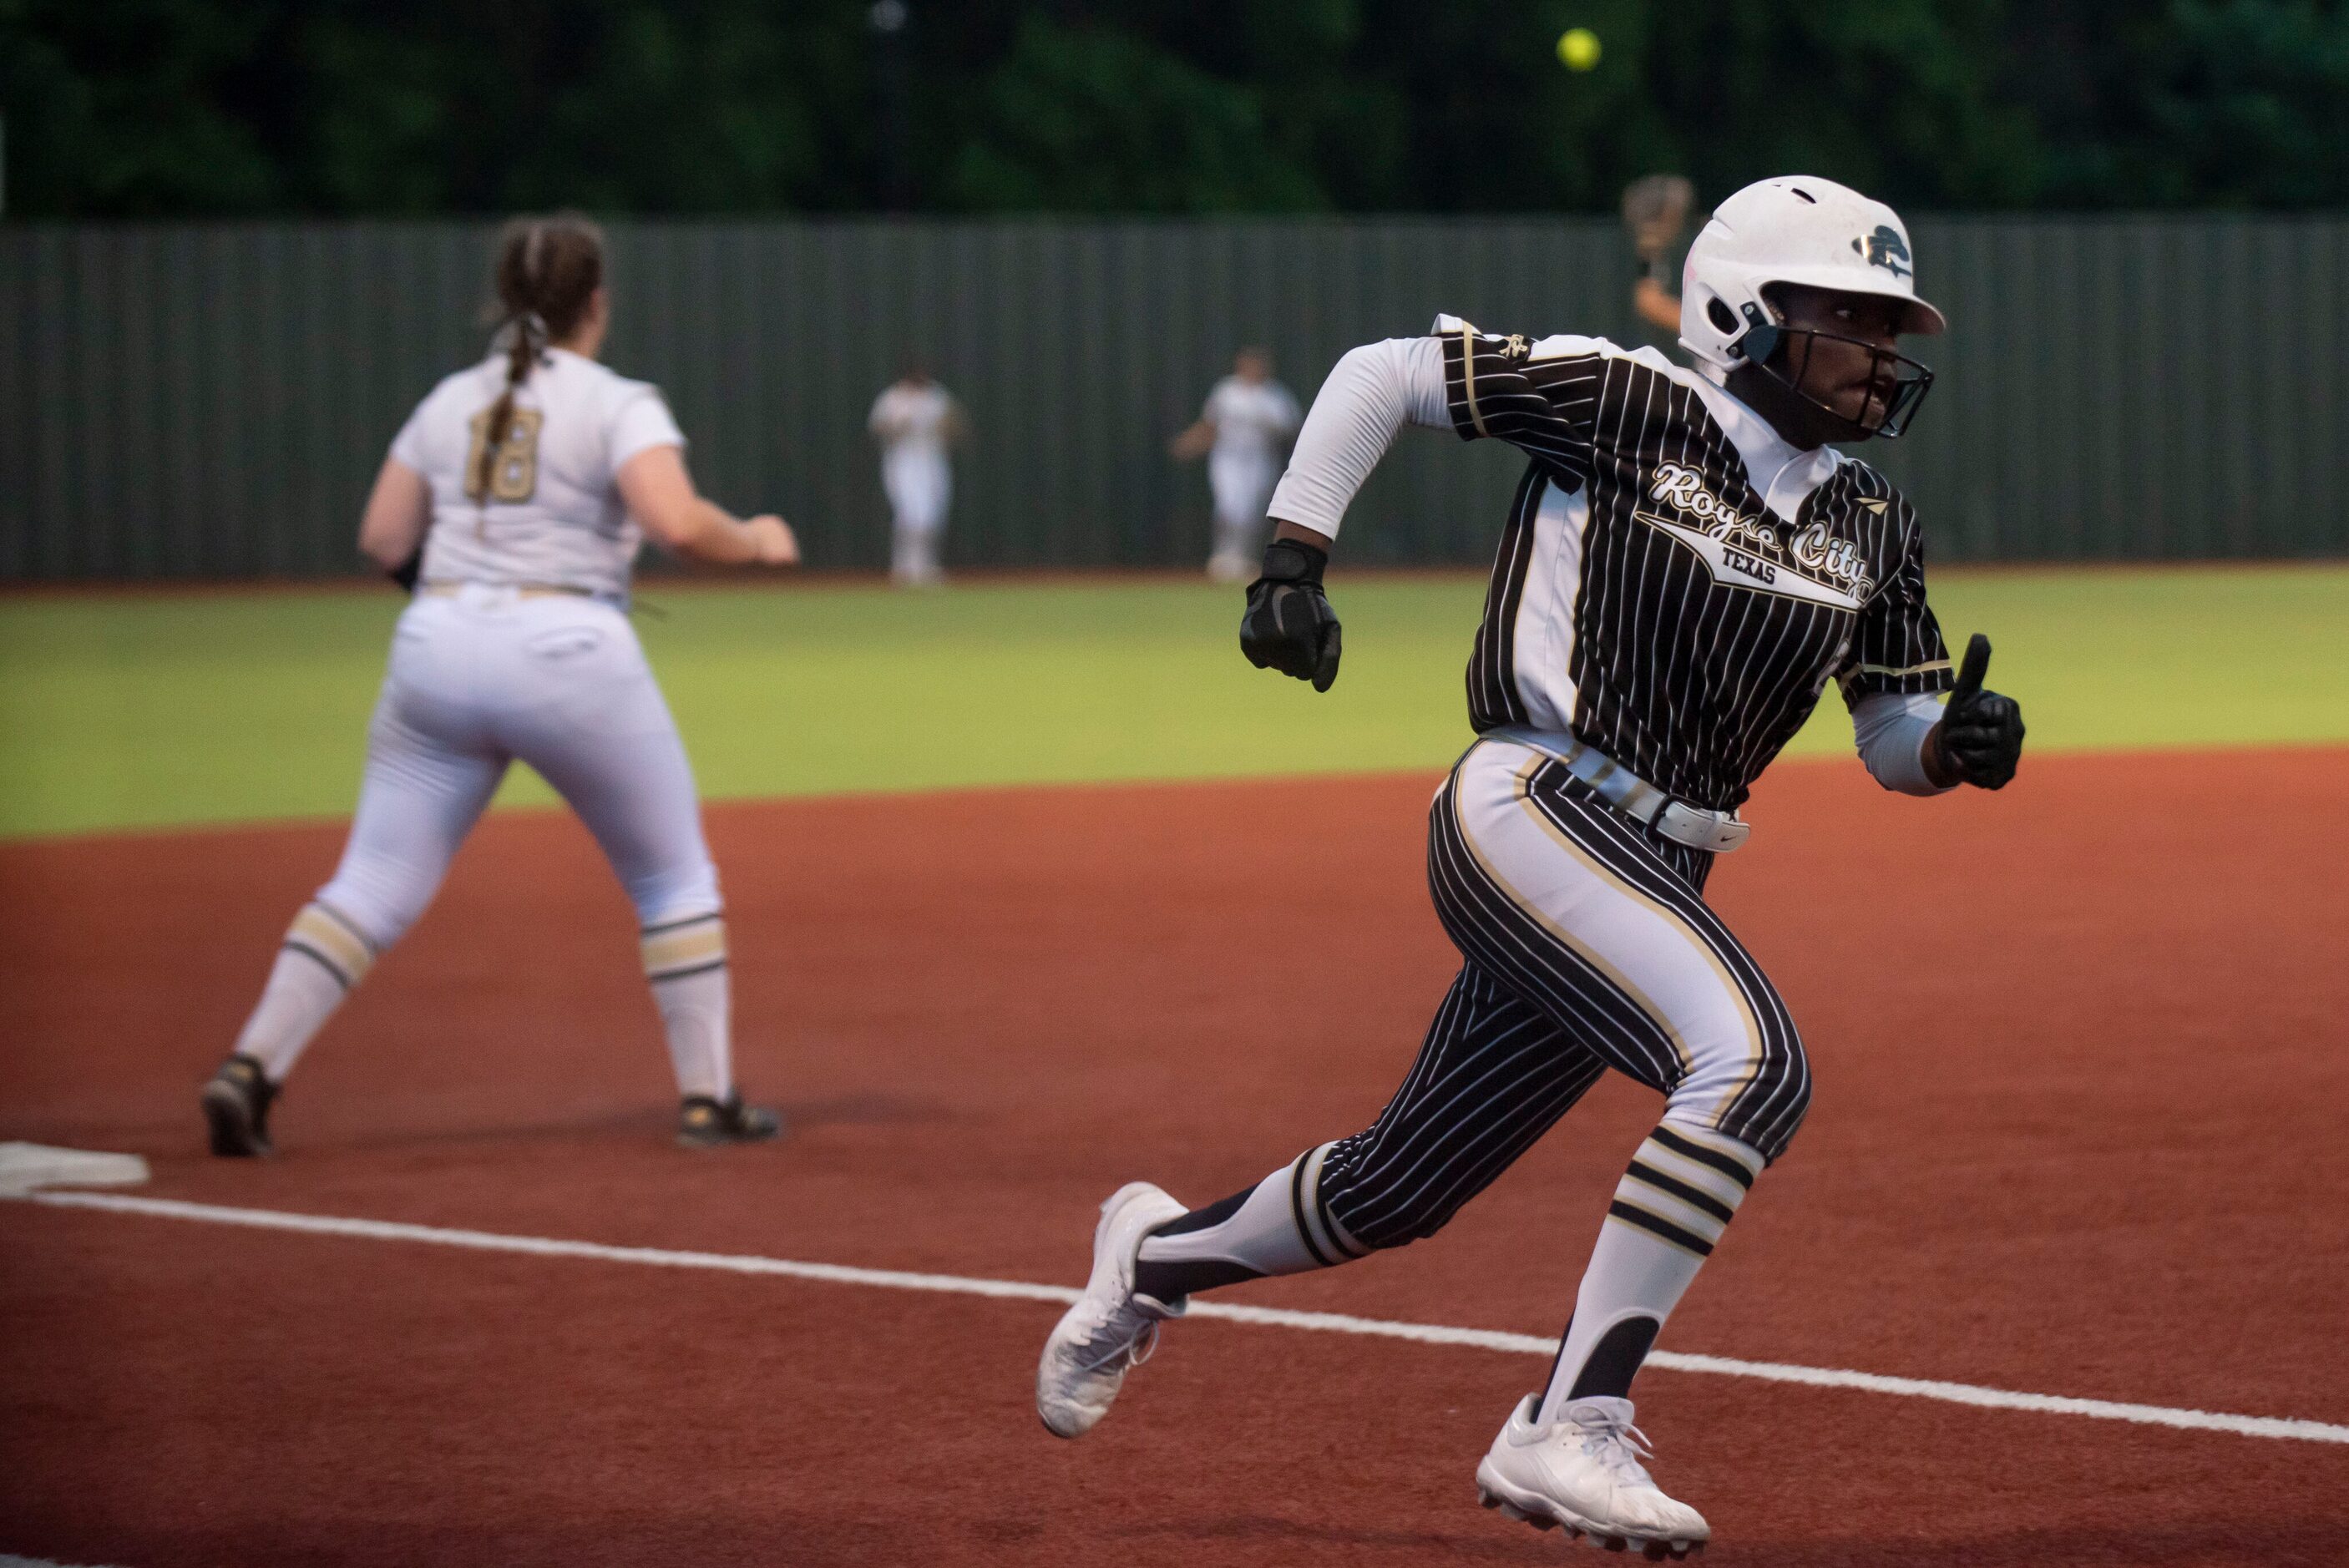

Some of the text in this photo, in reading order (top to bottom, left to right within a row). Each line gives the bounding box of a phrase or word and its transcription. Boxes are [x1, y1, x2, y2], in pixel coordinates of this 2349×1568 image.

[464, 407, 544, 503] 18
[1648, 460, 1874, 602] Royse City
[1723, 548, 1776, 584] TEXAS
